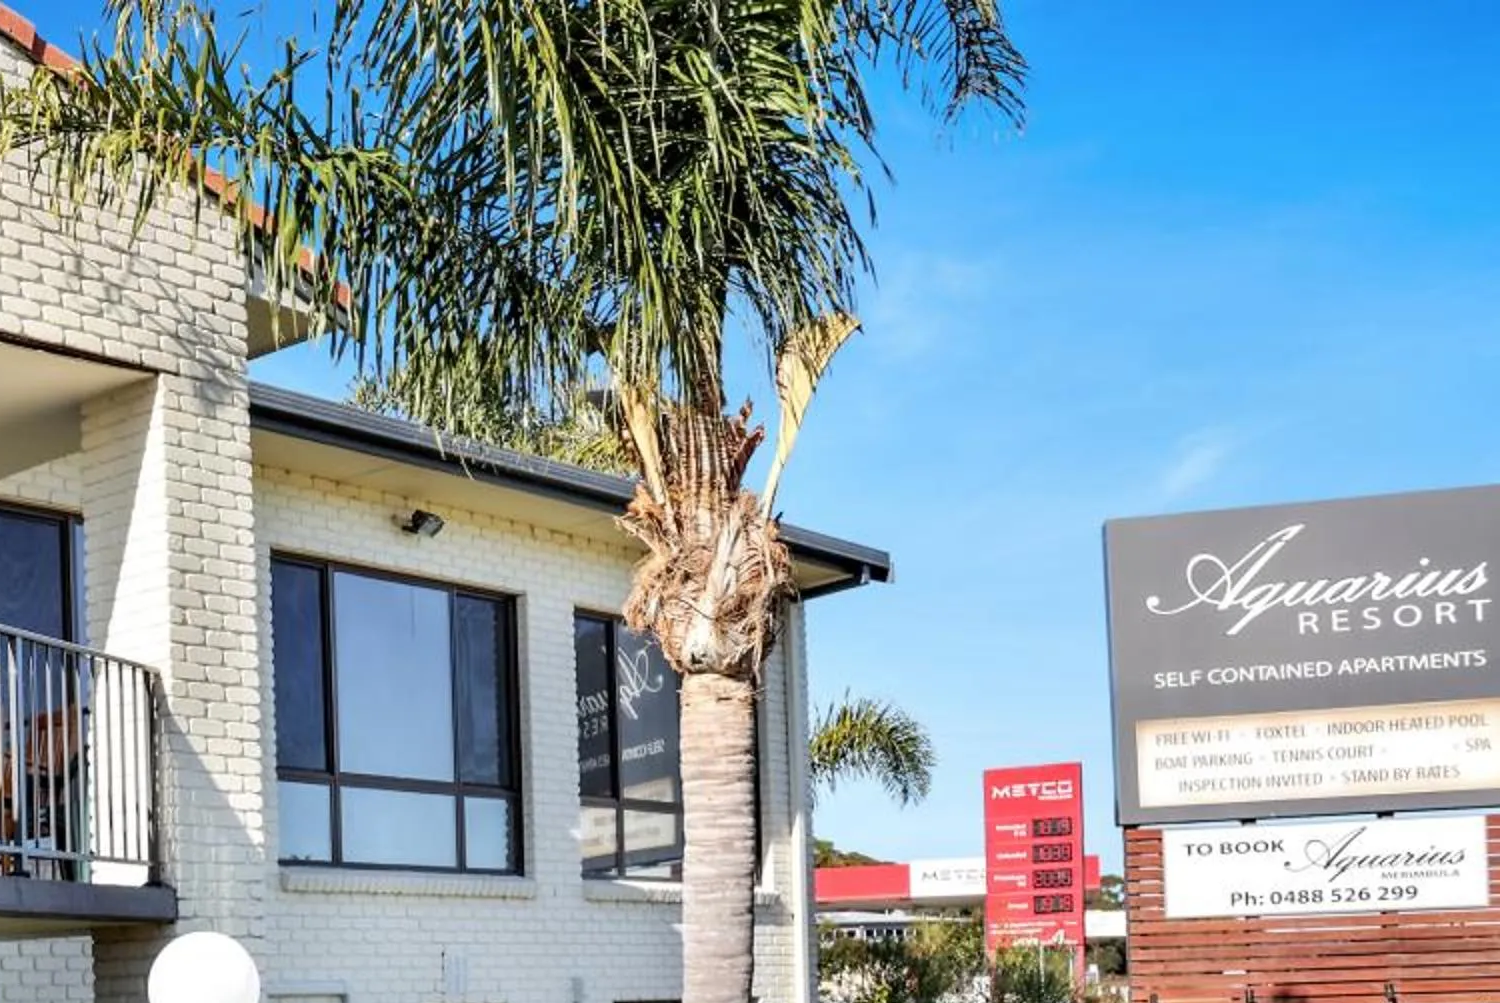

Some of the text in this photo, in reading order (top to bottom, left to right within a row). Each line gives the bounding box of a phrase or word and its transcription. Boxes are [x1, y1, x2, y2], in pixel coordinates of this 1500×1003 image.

[1146, 523, 1489, 635] Aquarius
[1299, 599, 1492, 634] RESORT
[1154, 649, 1488, 689] SELF CONTAINED APARTMENTS
[1155, 713, 1490, 746] FREE WI-FI FOXTEL INDOOR HEATED POOL
[1155, 738, 1492, 771] BOAT PARKING TENNIS COURT SPA
[1178, 765, 1461, 793] INSPECTION INVITED STAND BY RATES
[1185, 839, 1285, 857] TO BOOK
[1284, 826, 1466, 883] Aquarius
[1231, 885, 1418, 907] Ph: 0488 526 299
